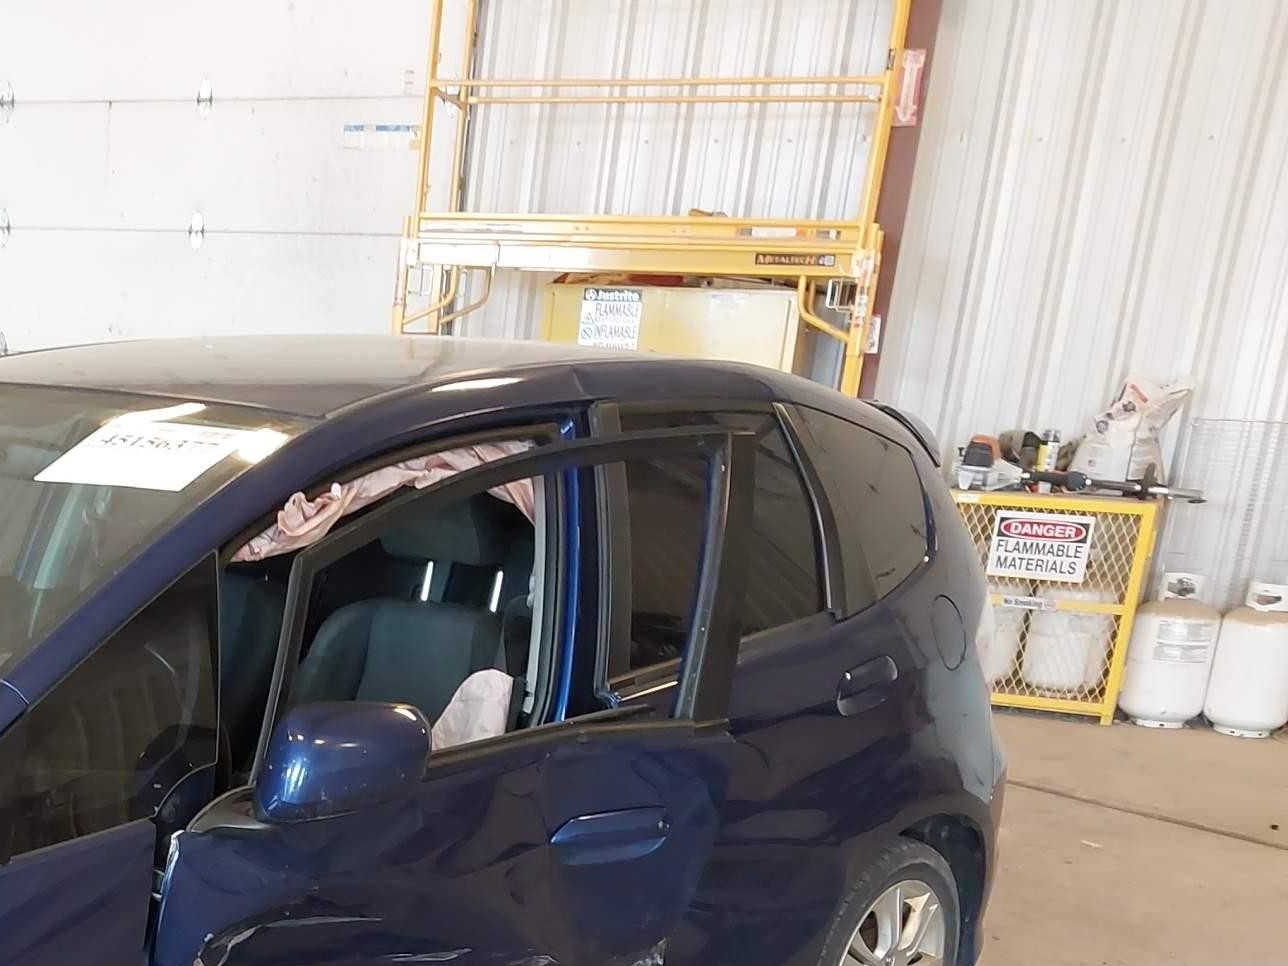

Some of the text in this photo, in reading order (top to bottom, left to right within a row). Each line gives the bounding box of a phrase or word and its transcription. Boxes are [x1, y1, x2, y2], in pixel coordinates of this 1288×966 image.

[597, 289, 640, 302] Justrite
[1010, 522, 1077, 538] DANGER
[996, 539, 1084, 559] FLAMMABLE
[995, 555, 1078, 575] MATERIALS
[1003, 597, 1012, 605] No
[1013, 598, 1043, 608] Smoking
